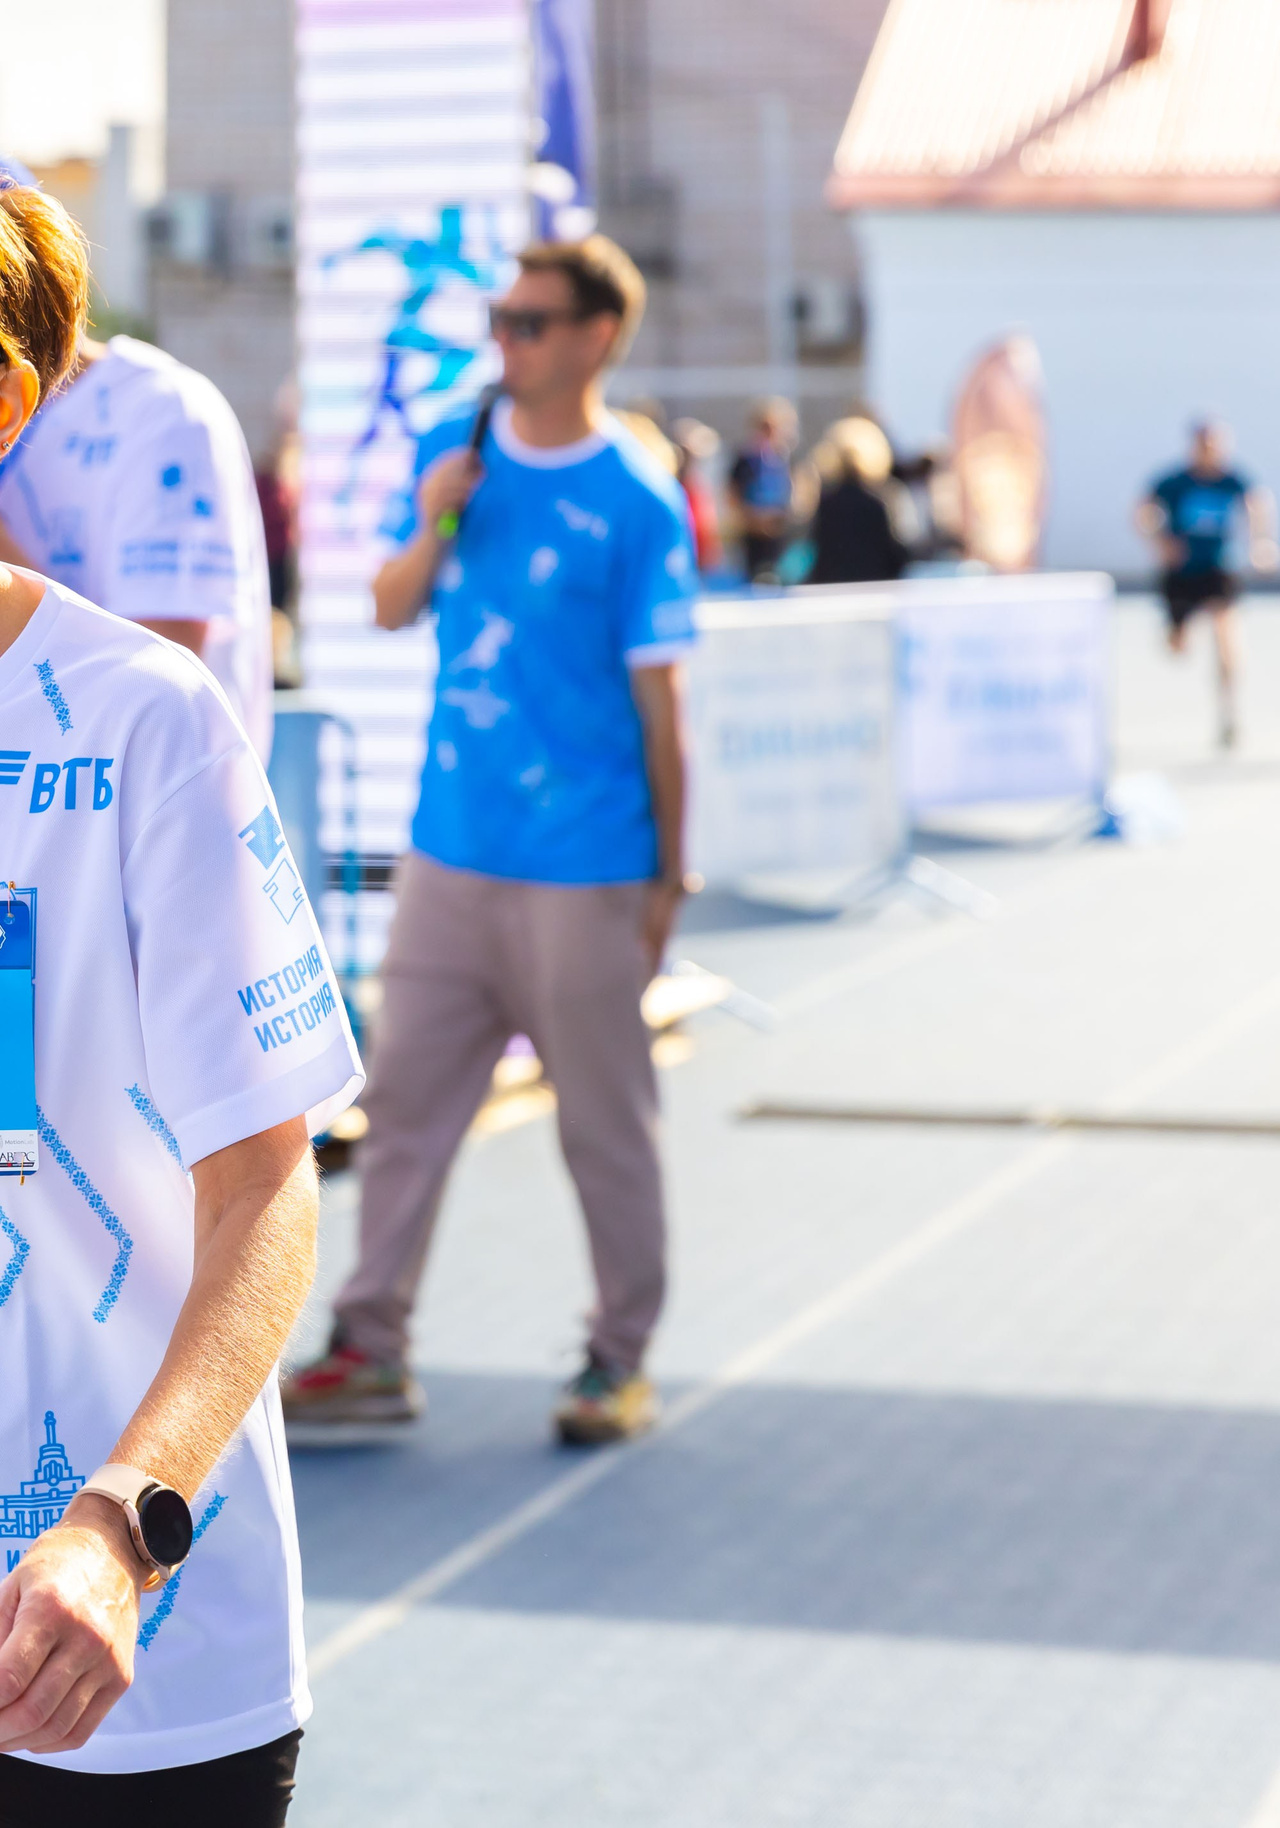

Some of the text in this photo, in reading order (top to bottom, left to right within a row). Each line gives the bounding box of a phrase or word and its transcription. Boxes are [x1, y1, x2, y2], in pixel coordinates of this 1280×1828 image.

[29, 758, 114, 813] ВТБ
[237, 944, 324, 1016] ИСТОРИЯ
[254, 981, 336, 1052] ИСТОРИЯ
